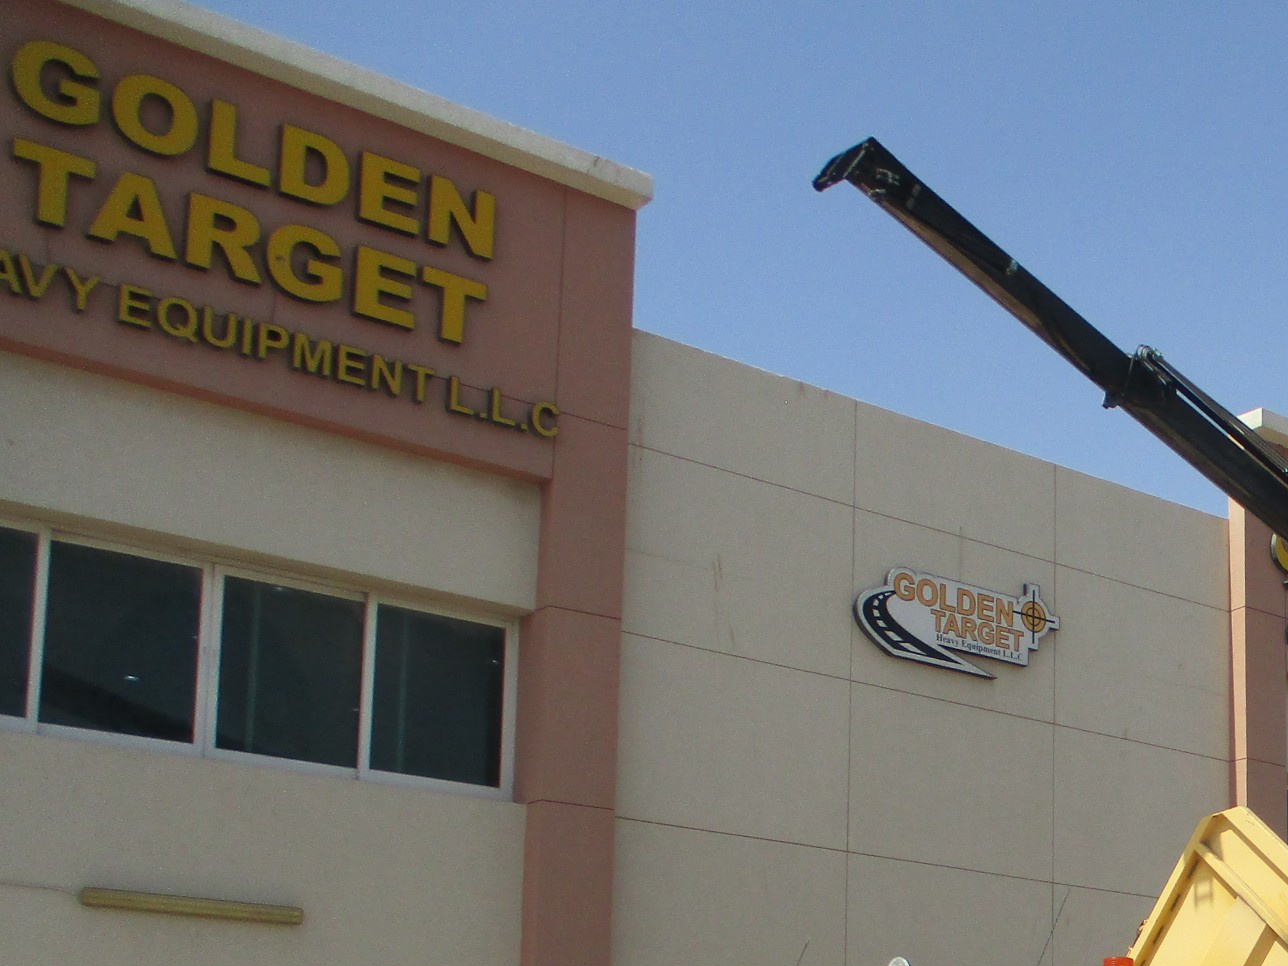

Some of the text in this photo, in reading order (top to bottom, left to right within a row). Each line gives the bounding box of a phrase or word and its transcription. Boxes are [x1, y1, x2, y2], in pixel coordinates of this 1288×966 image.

[11, 41, 496, 260] GOLDEN
[13, 138, 487, 345] TARGET
[117, 287, 435, 405] EQUIPMENT
[447, 375, 560, 438] L.L.C
[893, 572, 1014, 627] GOLDEN
[930, 608, 1025, 652] TARGET
[936, 633, 959, 648] Heavy
[961, 639, 1001, 656] Equipment
